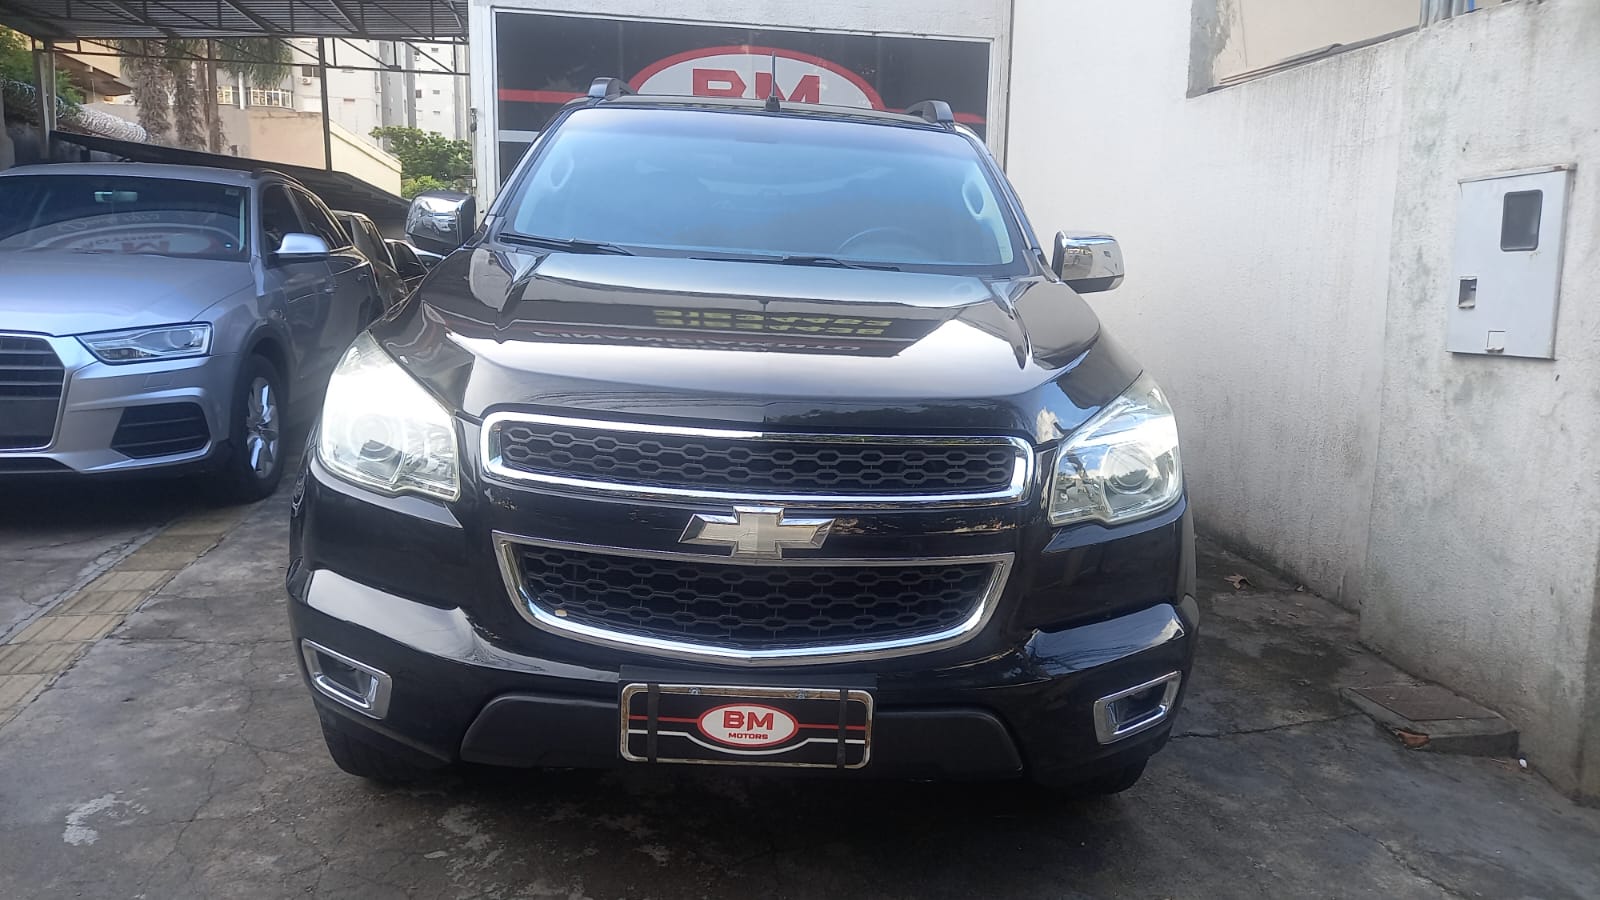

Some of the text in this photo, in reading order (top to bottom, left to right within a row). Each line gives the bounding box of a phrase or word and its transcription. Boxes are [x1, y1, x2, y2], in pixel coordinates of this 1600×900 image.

[692, 68, 820, 104] BM
[723, 710, 774, 731] BM
[728, 732, 769, 740] MOTORS
